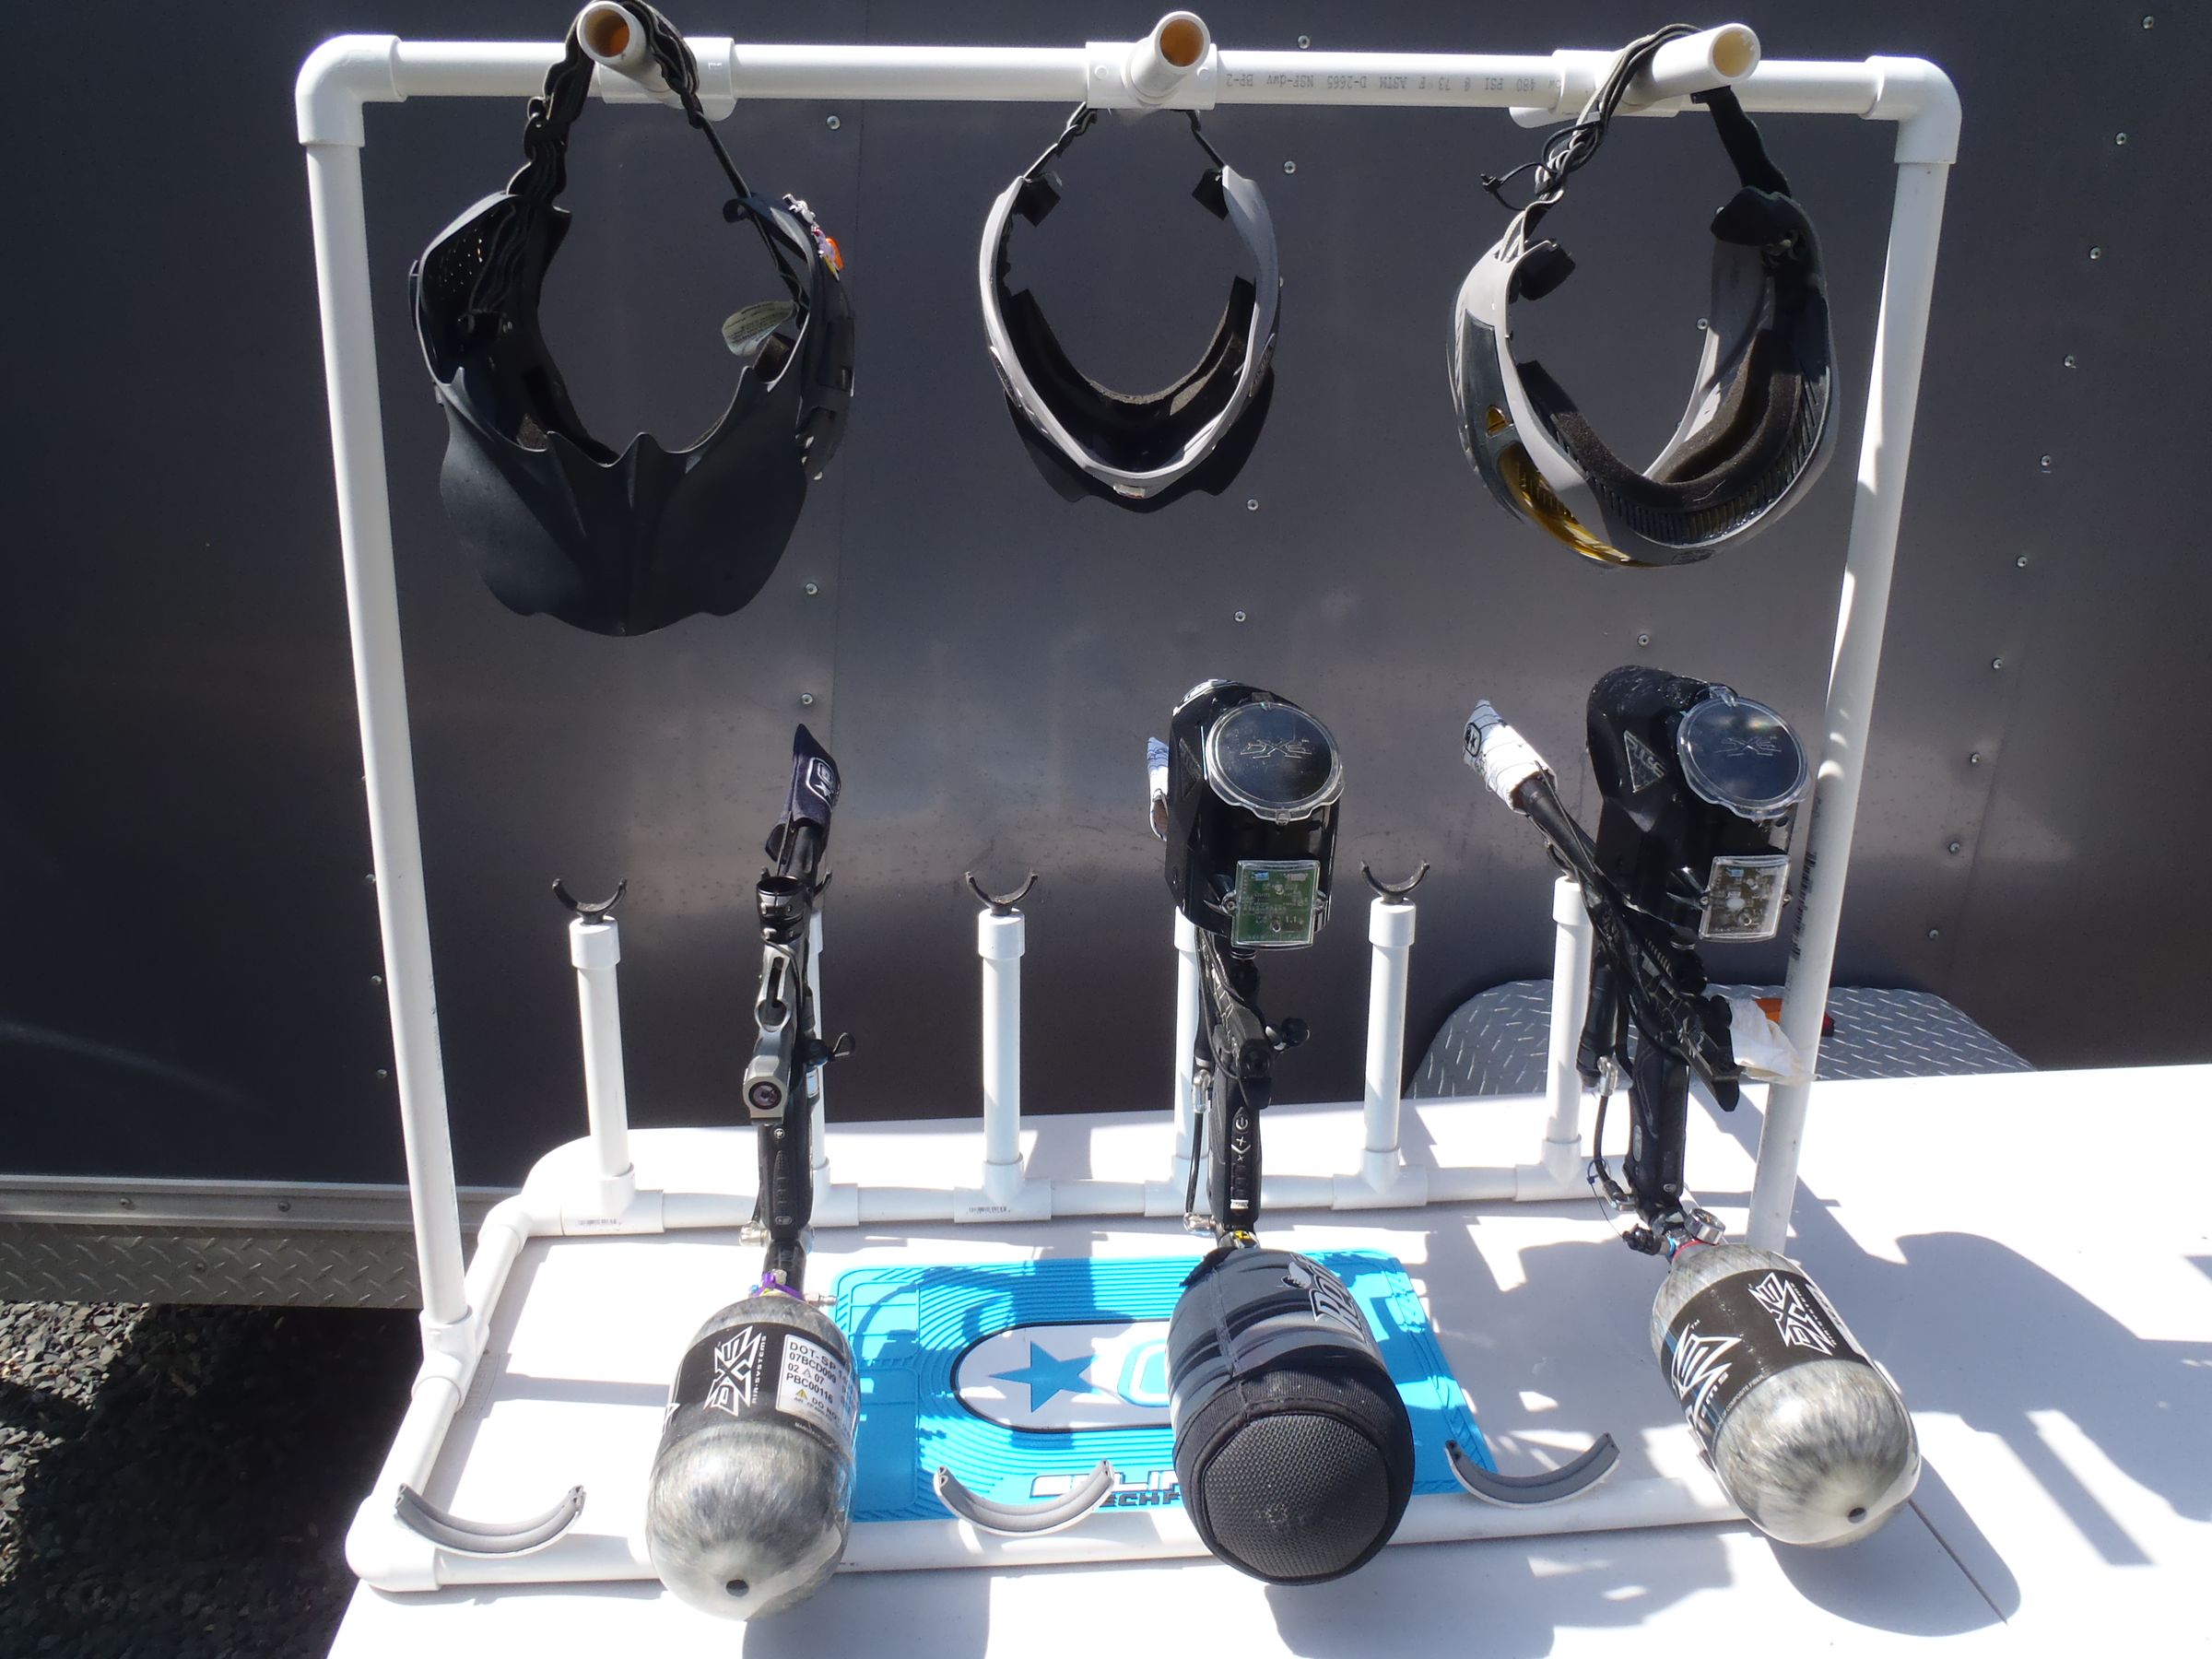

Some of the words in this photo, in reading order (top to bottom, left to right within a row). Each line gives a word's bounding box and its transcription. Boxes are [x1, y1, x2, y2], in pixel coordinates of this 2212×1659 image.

[1327, 76, 1367, 88] D-2665
[1379, 76, 1407, 89] ASTM
[1438, 77, 1452, 90] 73
[1485, 77, 1504, 90] PSI
[1516, 78, 1536, 91] 480
[790, 1342, 836, 1370] DOT-SP
[788, 1363, 800, 1373] 02
[815, 1374, 825, 1385] 07
[786, 1372, 833, 1404] PBC00116
